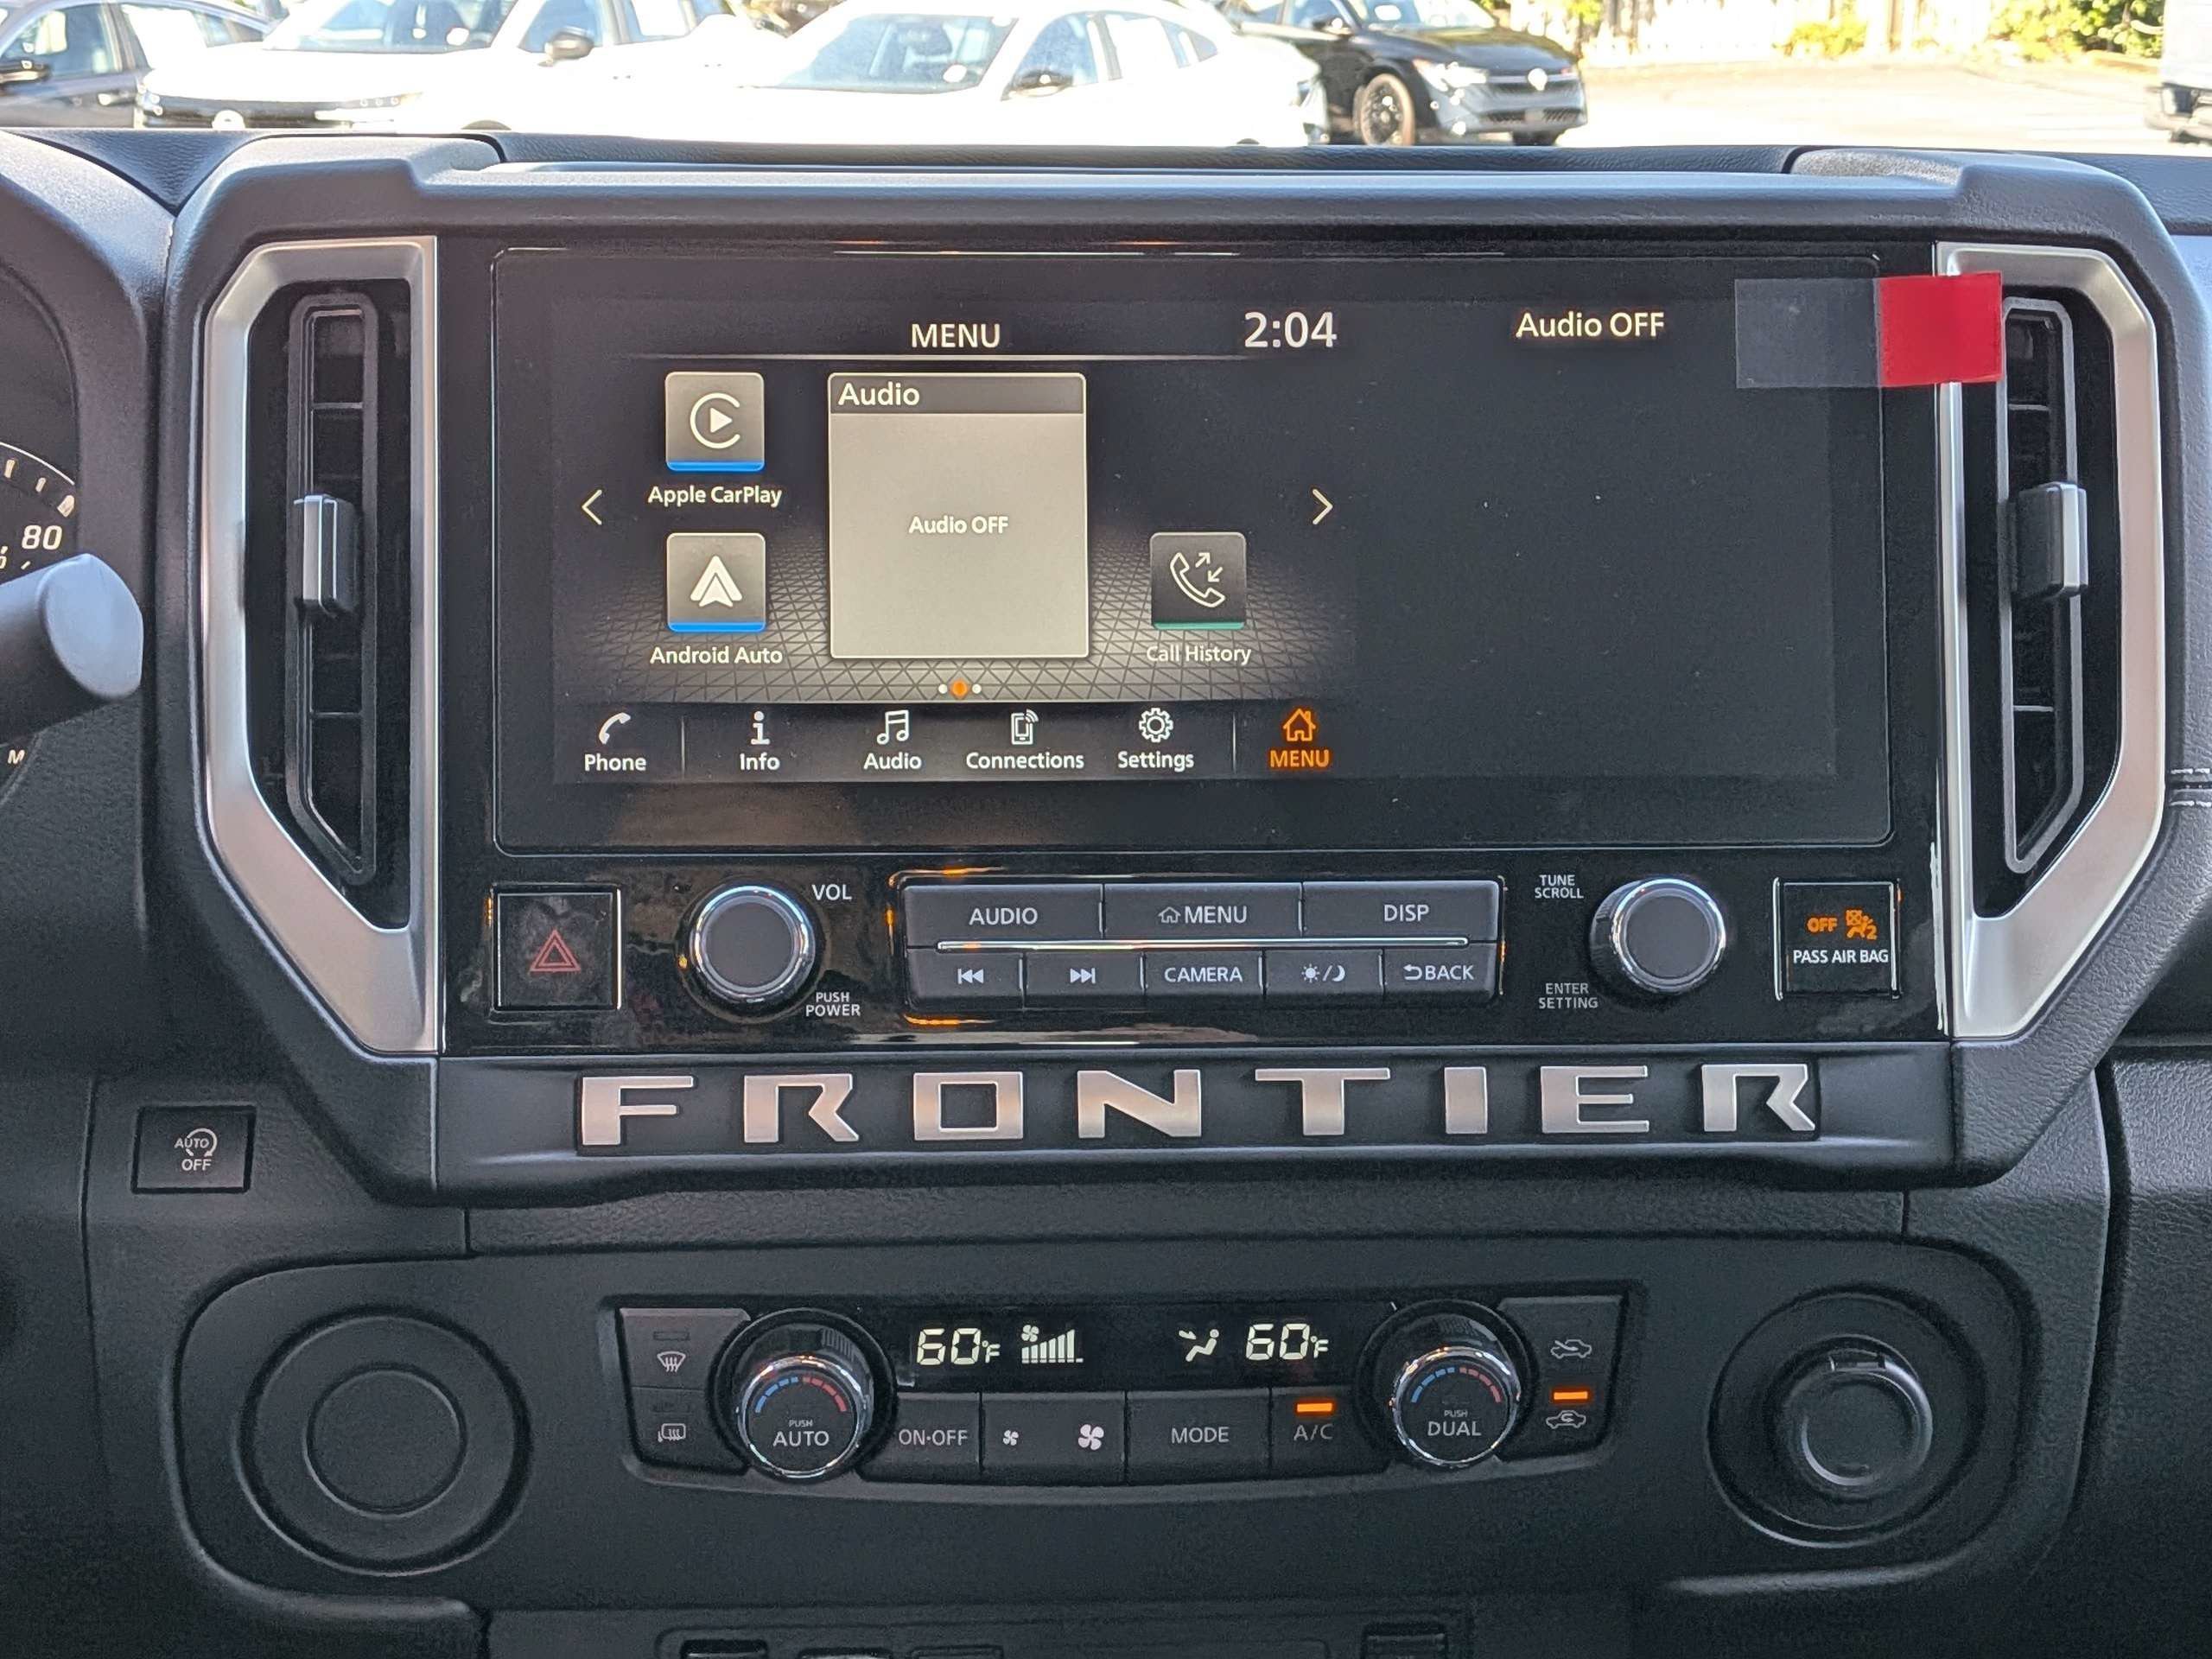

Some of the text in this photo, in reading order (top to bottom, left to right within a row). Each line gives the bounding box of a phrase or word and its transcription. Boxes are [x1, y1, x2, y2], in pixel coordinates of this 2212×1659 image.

[1244, 312, 1338, 348] 2:04
[1516, 312, 1665, 338] Audio OFF
[911, 323, 1001, 348] MENU
[837, 383, 920, 407] Audio
[647, 485, 782, 508] Apple CarPlay
[908, 515, 1009, 534] Audio OFF
[22, 524, 62, 550] 80
[650, 646, 783, 664] Android Auto
[1146, 645, 1252, 665] Call History
[584, 754, 646, 772] Phone
[740, 753, 780, 771] Info
[863, 753, 922, 770] Audio
[966, 753, 1084, 770] Connections
[1117, 752, 1195, 772] Settings
[1268, 749, 1331, 769] MENU
[1540, 875, 1575, 887] TUNE
[811, 883, 852, 902] VOL
[1535, 887, 1585, 899] SCROLL
[969, 907, 1039, 926] AUDIO
[1184, 906, 1249, 925] MENU
[1383, 904, 1430, 923] DISP
[1806, 917, 1838, 933] OFF
[1793, 949, 1890, 963] PASS AIR BAG
[1164, 967, 1243, 983] CAMERA
[1424, 965, 1474, 982] BACK
[815, 991, 850, 1003] PUSH
[1545, 983, 1589, 995] ENTER
[805, 1003, 861, 1017] POWER
[1538, 997, 1599, 1010] SETTING
[580, 1062, 1820, 1147] FRONTIER
[174, 1138, 210, 1148] AUTO
[181, 1159, 212, 1172] OFF
[1444, 1409, 1468, 1418] PUSH
[789, 1419, 813, 1427] PUSH
[1427, 1421, 1482, 1436] DUAL
[772, 1430, 830, 1447] AUTO
[1171, 1427, 1230, 1444] MODE
[1293, 1423, 1334, 1441] A/C
